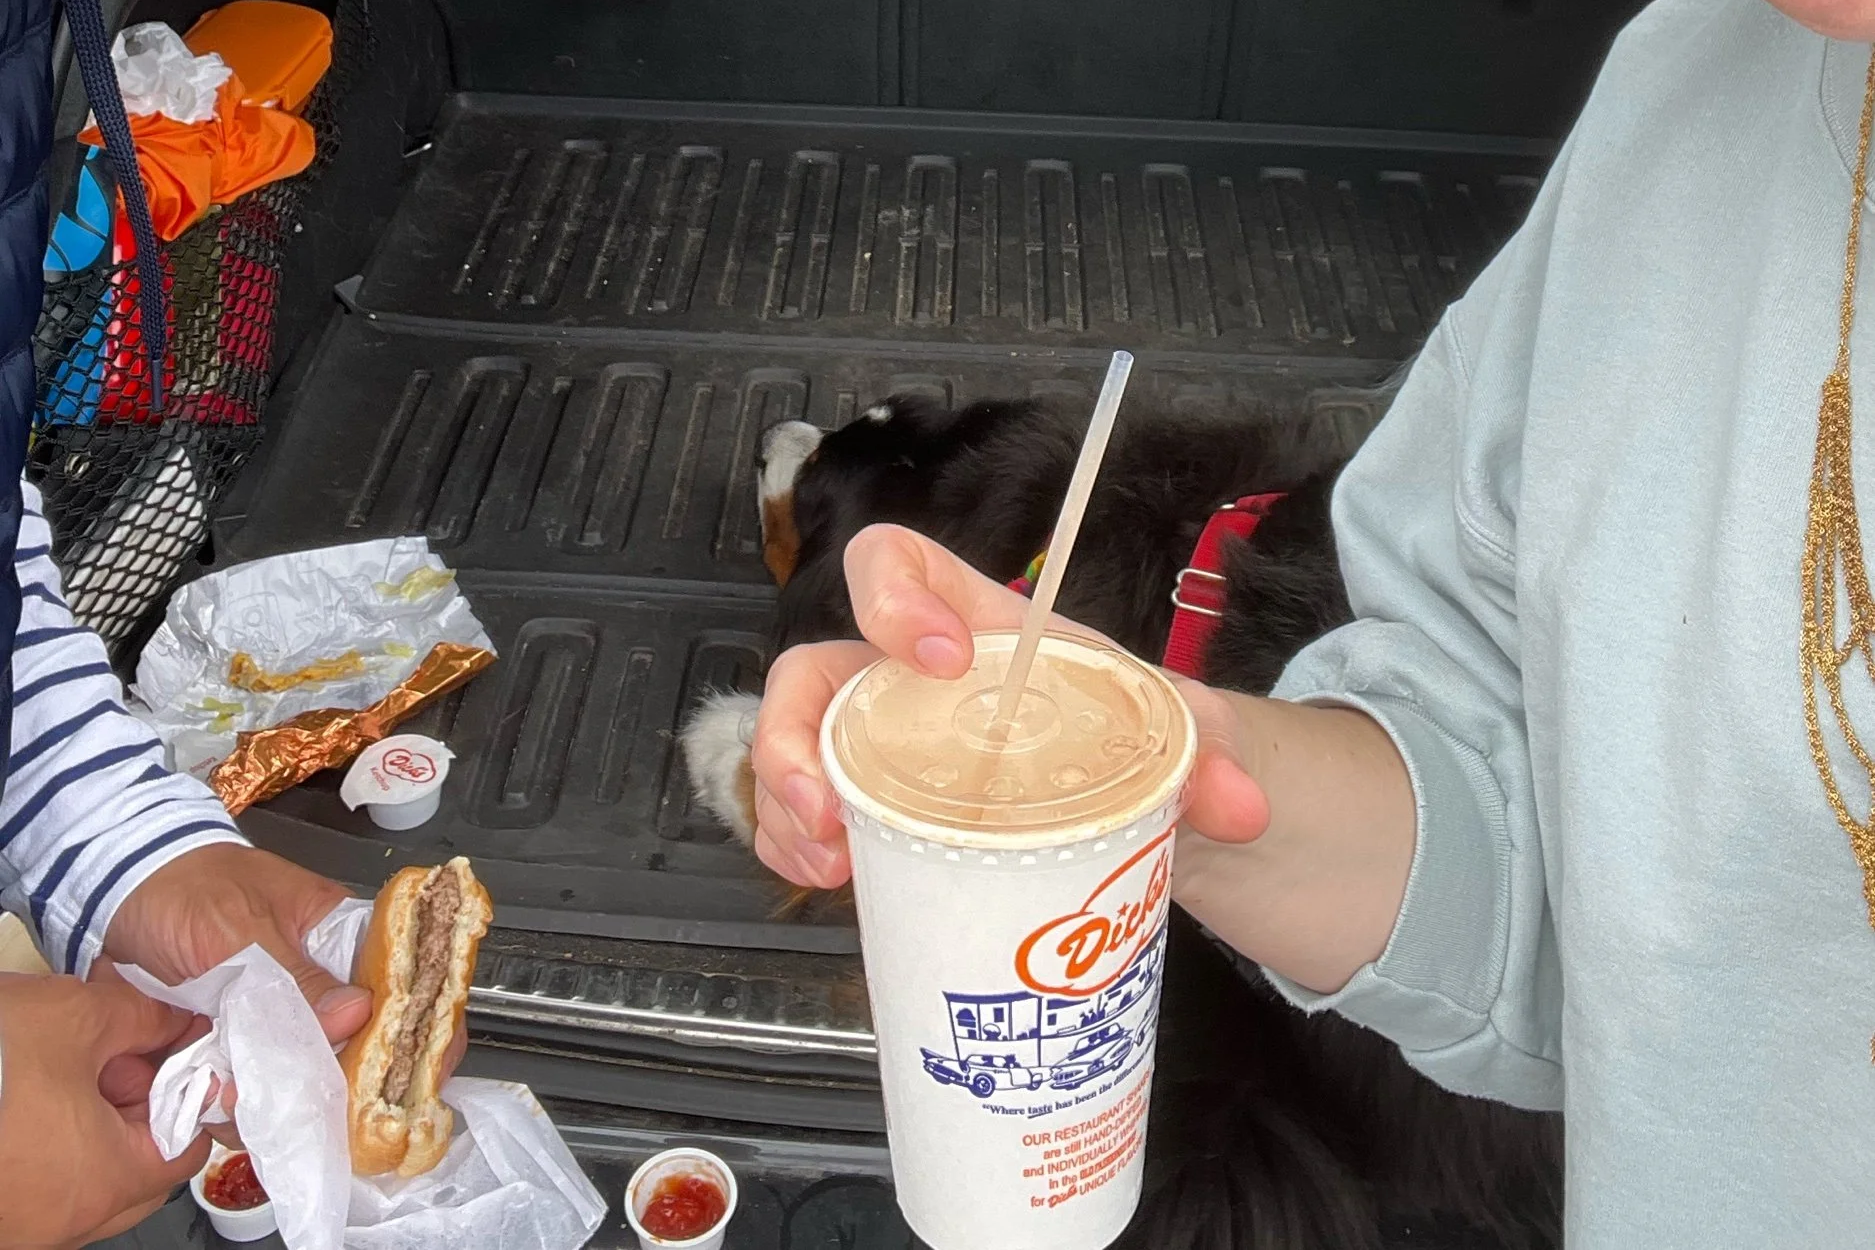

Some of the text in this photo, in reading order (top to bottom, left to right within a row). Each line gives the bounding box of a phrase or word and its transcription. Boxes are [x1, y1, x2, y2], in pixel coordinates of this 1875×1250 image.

[1028, 1103, 1053, 1119] taste
[1055, 1099, 1073, 1111] has
[1075, 1090, 1097, 1105] been
[1099, 1082, 1113, 1095] the
[1022, 1132, 1052, 1147] OUR
[1054, 1098, 1126, 1143] RESTAURANT
[1023, 1164, 1045, 1178] and
[1047, 1134, 1119, 1175] INDIVIDUALLY
[1043, 1147, 1062, 1160] are
[1064, 1140, 1082, 1156] still
[1030, 1196, 1046, 1208] for
[1079, 1169, 1117, 1195] UNIQUE
[1048, 1178, 1059, 1190] in
[1061, 1173, 1078, 1188] the
